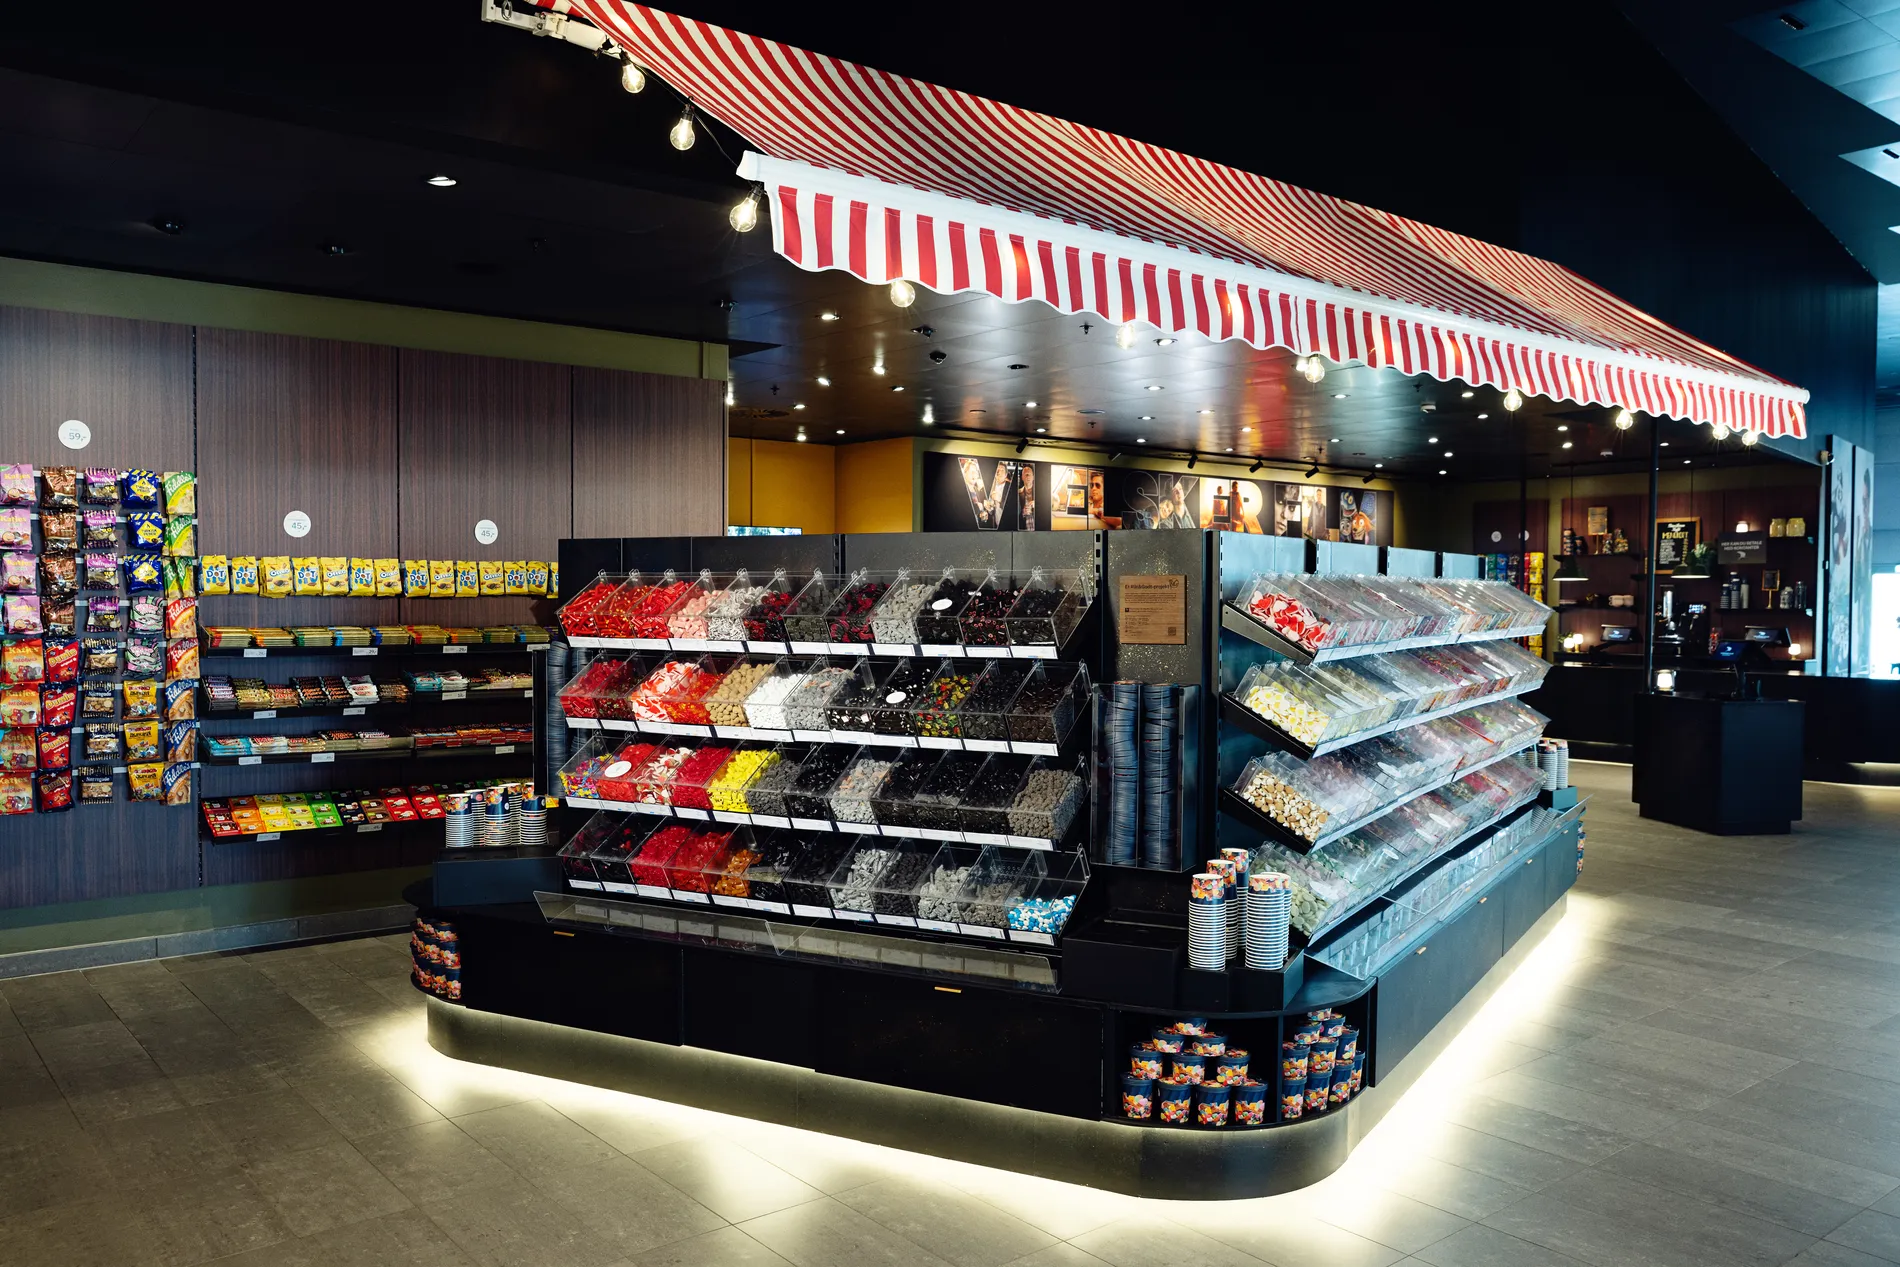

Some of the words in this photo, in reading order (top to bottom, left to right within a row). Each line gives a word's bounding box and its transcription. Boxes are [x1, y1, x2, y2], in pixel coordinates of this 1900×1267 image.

[957, 457, 1037, 531] VI
[9, 646, 39, 655] Katjes
[6, 690, 36, 698] Katjes
[4, 733, 33, 742] Katjes
